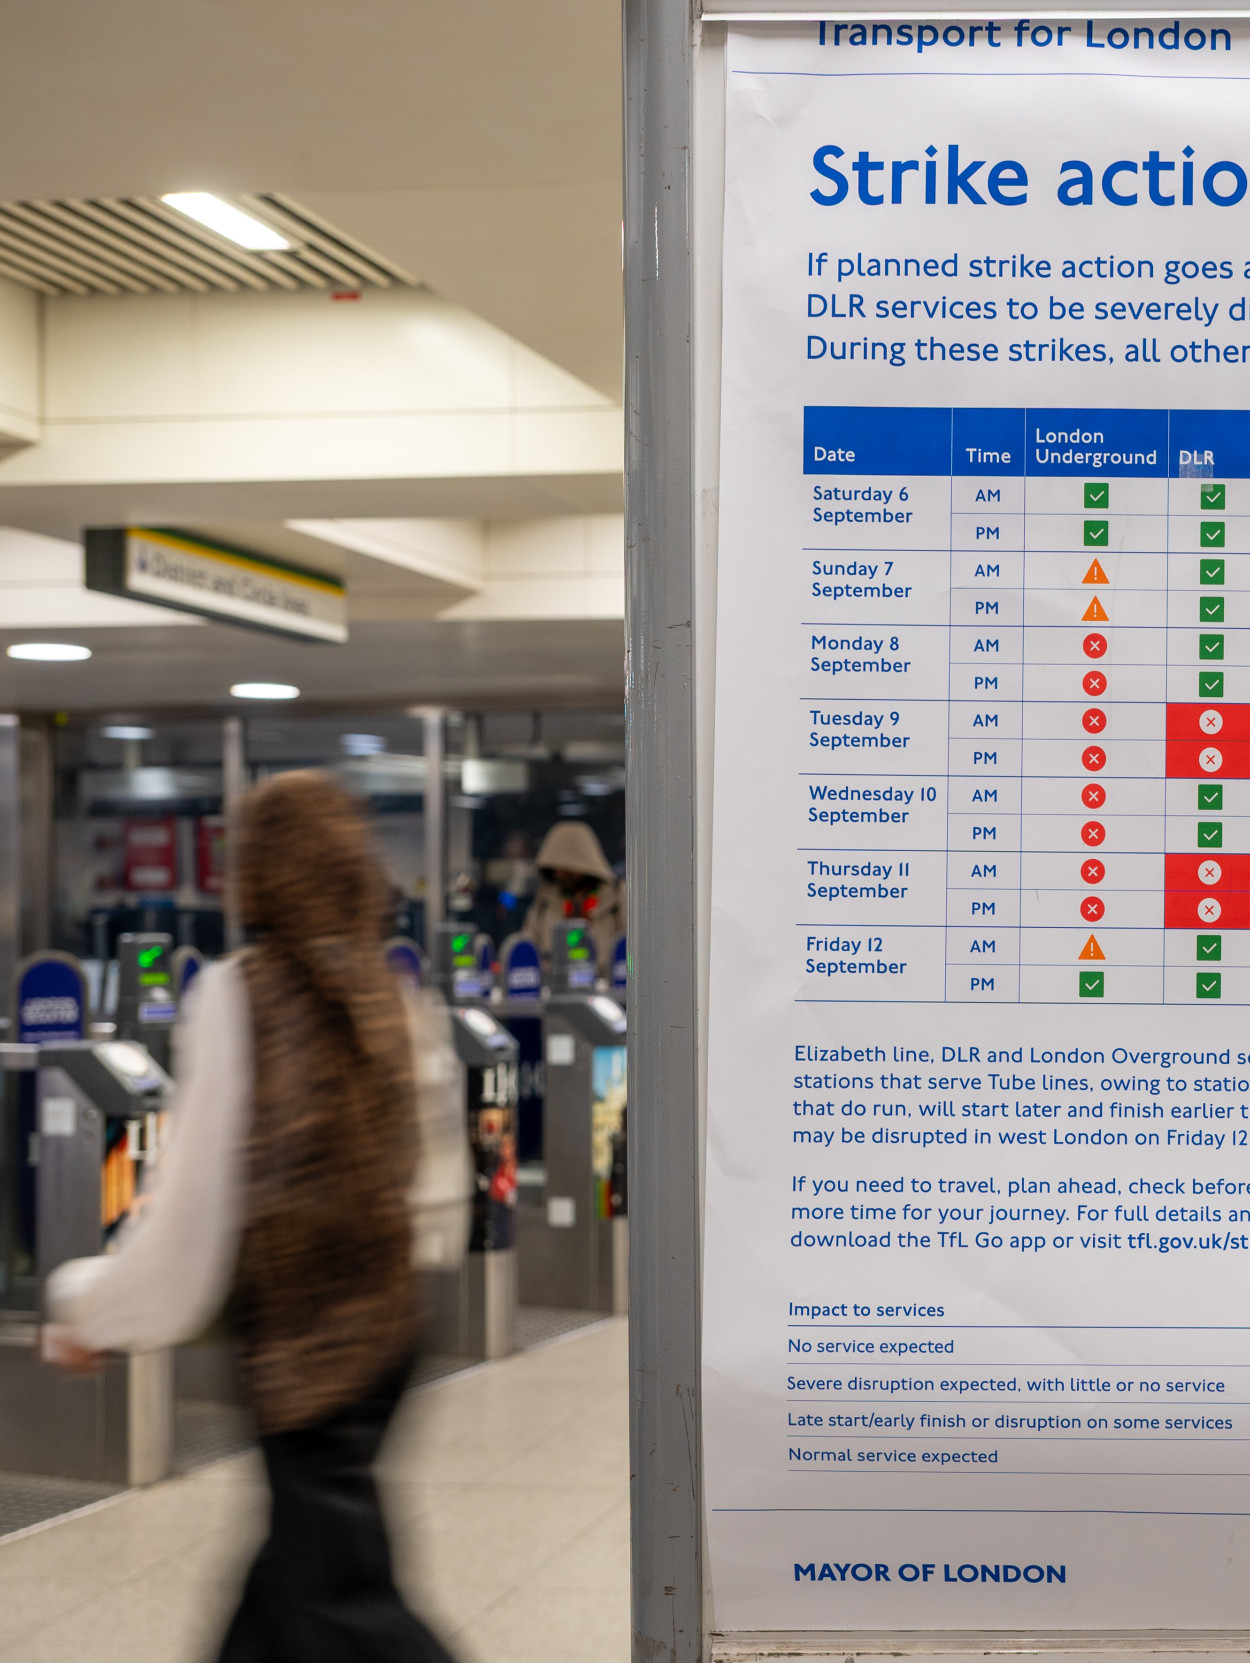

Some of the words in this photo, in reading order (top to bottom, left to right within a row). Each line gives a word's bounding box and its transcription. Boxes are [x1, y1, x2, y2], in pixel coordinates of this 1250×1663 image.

[1015, 19, 1071, 47] for
[1087, 20, 1231, 50] London
[810, 145, 1028, 206] Strike
[808, 252, 828, 276] If
[838, 252, 958, 282] planned
[969, 254, 1051, 278] strike
[1062, 256, 1154, 278] action
[1164, 261, 1233, 284] goes
[808, 294, 865, 317] DLR
[876, 296, 997, 319] services
[1006, 298, 1038, 320] to
[1050, 296, 1084, 320] be
[1095, 297, 1219, 326] severely
[807, 336, 906, 366] During
[915, 336, 998, 361] these
[1009, 337, 1113, 363] strikes,
[1125, 338, 1160, 362] all
[1036, 428, 1104, 443] London
[814, 446, 855, 462] Date
[966, 448, 1011, 463] Time
[1036, 448, 1156, 468] Underground
[1179, 450, 1214, 466] DLR
[814, 486, 893, 504] Saturday
[899, 487, 909, 501] 6
[976, 489, 1000, 502] AM
[814, 508, 912, 526] September
[976, 527, 999, 540] PM
[813, 561, 878, 579] Sunday
[884, 561, 893, 575] 7
[812, 636, 883, 654] Monday
[890, 637, 899, 650] 8
[974, 639, 999, 652] AM
[811, 657, 911, 675] September
[974, 676, 998, 689] PM
[810, 710, 884, 729] Tuesday
[890, 712, 899, 725] 9
[809, 786, 914, 804] Wednesday
[922, 787, 936, 801] 10
[972, 789, 997, 802] AM
[808, 807, 909, 825] September
[973, 827, 996, 840] PM
[808, 861, 892, 880] Thursday
[900, 863, 909, 877] 11
[807, 937, 861, 955] Friday
[868, 937, 882, 952] 12
[970, 940, 995, 952] AM
[806, 959, 907, 976] September
[971, 977, 994, 991] PM
[796, 1045, 886, 1062] Elizabeth
[894, 1046, 934, 1063] line,
[942, 1046, 980, 1062] DLR
[988, 1048, 1022, 1063] and
[1031, 1048, 1104, 1063] London
[1112, 1048, 1230, 1068] Overground
[794, 1131, 834, 1146] may
[842, 1128, 864, 1143] be
[872, 1128, 967, 1148] disrupted
[975, 1129, 991, 1144] in
[999, 1130, 1046, 1144] west
[1054, 1128, 1127, 1144] London
[1135, 1133, 1159, 1145] on
[1168, 1129, 1225, 1149] Friday
[1233, 1130, 1248, 1146] 12
[793, 1176, 806, 1192] If
[813, 1180, 848, 1196] you
[856, 1177, 904, 1192] need
[912, 1179, 931, 1192] to
[939, 1177, 1000, 1194] travel,
[1008, 1177, 1050, 1196] plan
[1058, 1177, 1121, 1195] ahead,
[1129, 1178, 1185, 1194] check
[791, 1231, 891, 1248] download
[898, 1232, 931, 1248] the
[938, 1232, 968, 1247] TfL
[975, 1232, 1003, 1248] Go
[1010, 1236, 1046, 1252] app
[1053, 1236, 1074, 1248] or
[1080, 1233, 1121, 1248] visit
[789, 1302, 848, 1320] Impact
[852, 1304, 871, 1317] to
[876, 1304, 944, 1317] services
[789, 1339, 812, 1352] No
[817, 1341, 875, 1353] service
[880, 1340, 954, 1356] expected
[787, 1376, 842, 1390] Severe
[848, 1377, 934, 1394] disruption
[940, 1378, 1020, 1394] expected,
[1027, 1378, 1064, 1391] with
[1071, 1378, 1110, 1392] little
[1116, 1381, 1134, 1392] or
[1140, 1381, 1160, 1392] no
[1166, 1379, 1224, 1392] service
[789, 1448, 852, 1462] Normal
[857, 1450, 916, 1463] service
[921, 1450, 998, 1466] expected
[794, 1563, 891, 1581] MAYOR
[898, 1564, 935, 1582] OF
[944, 1564, 1066, 1583] LONDON
